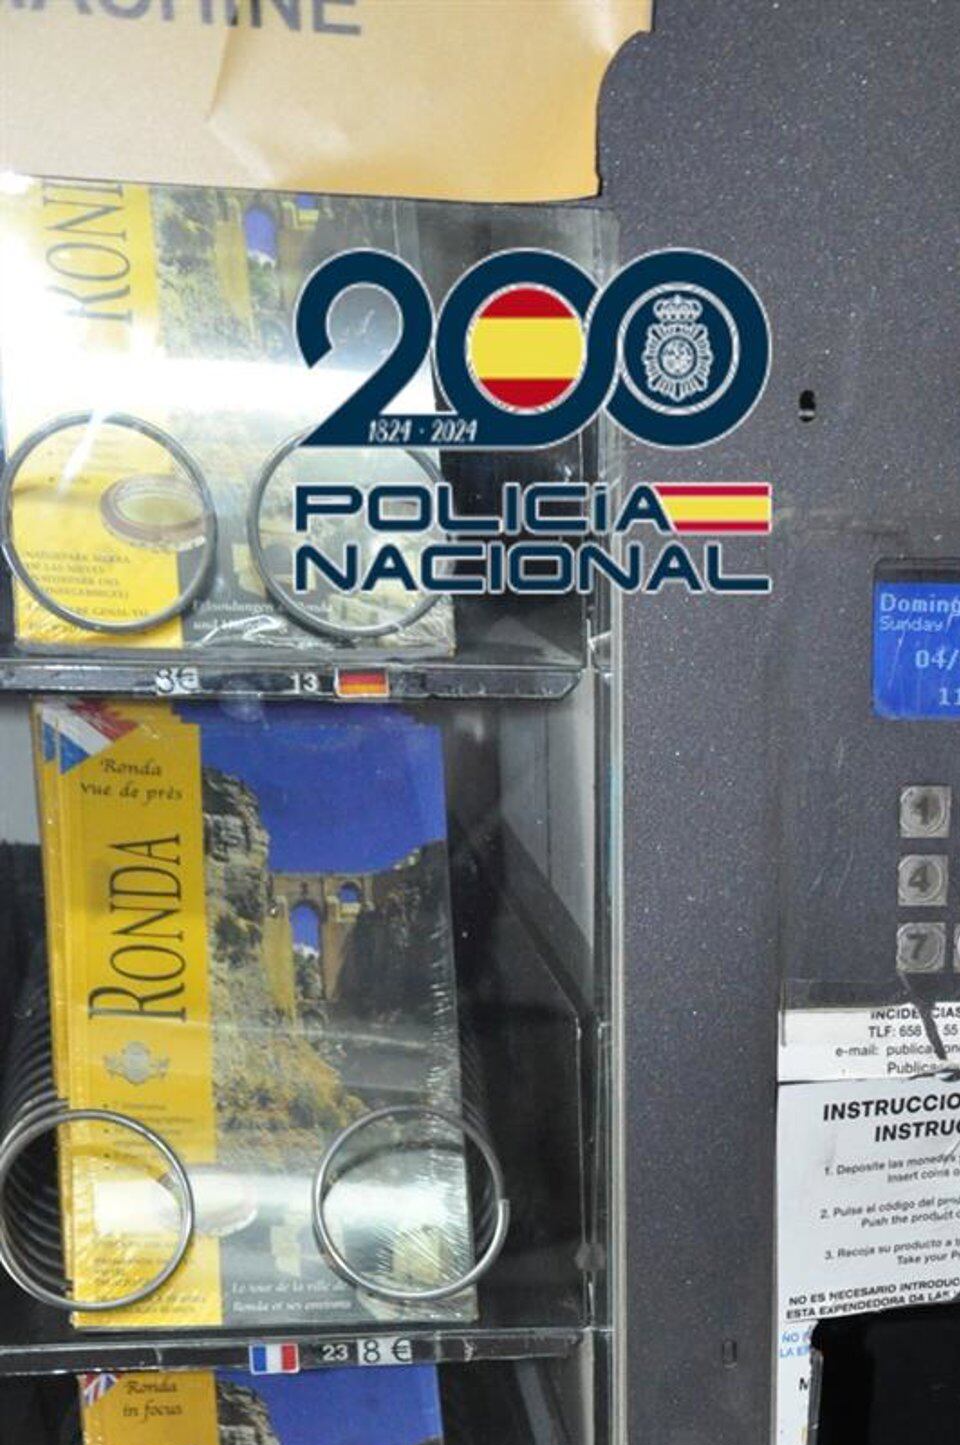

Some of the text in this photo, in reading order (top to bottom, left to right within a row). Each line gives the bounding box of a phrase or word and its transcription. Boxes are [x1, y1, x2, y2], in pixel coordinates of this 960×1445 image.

[42, 182, 133, 325] RON
[879, 615, 943, 632] Sunday
[289, 674, 319, 693] 13
[101, 758, 162, 776] Ronda
[119, 780, 140, 797] de
[915, 796, 929, 825] 1
[908, 865, 930, 893] 4
[88, 833, 187, 1023] RONDA
[906, 932, 928, 960] 7
[837, 1162, 885, 1176] Deposite
[888, 1158, 904, 1169] las
[918, 1197, 934, 1208] del
[891, 1214, 908, 1225] the
[911, 1209, 953, 1224] product
[894, 1238, 943, 1254] producto
[924, 1252, 949, 1265] your
[788, 1294, 808, 1306] NO
[810, 1292, 826, 1303] ES
[828, 1284, 898, 1301] NECESARIO
[786, 1307, 816, 1319] ESTA
[819, 1296, 906, 1315] EXPENDEDORA
[322, 1344, 349, 1361] 23
[125, 1375, 178, 1395] Ronda
[140, 1398, 183, 1423] focus
